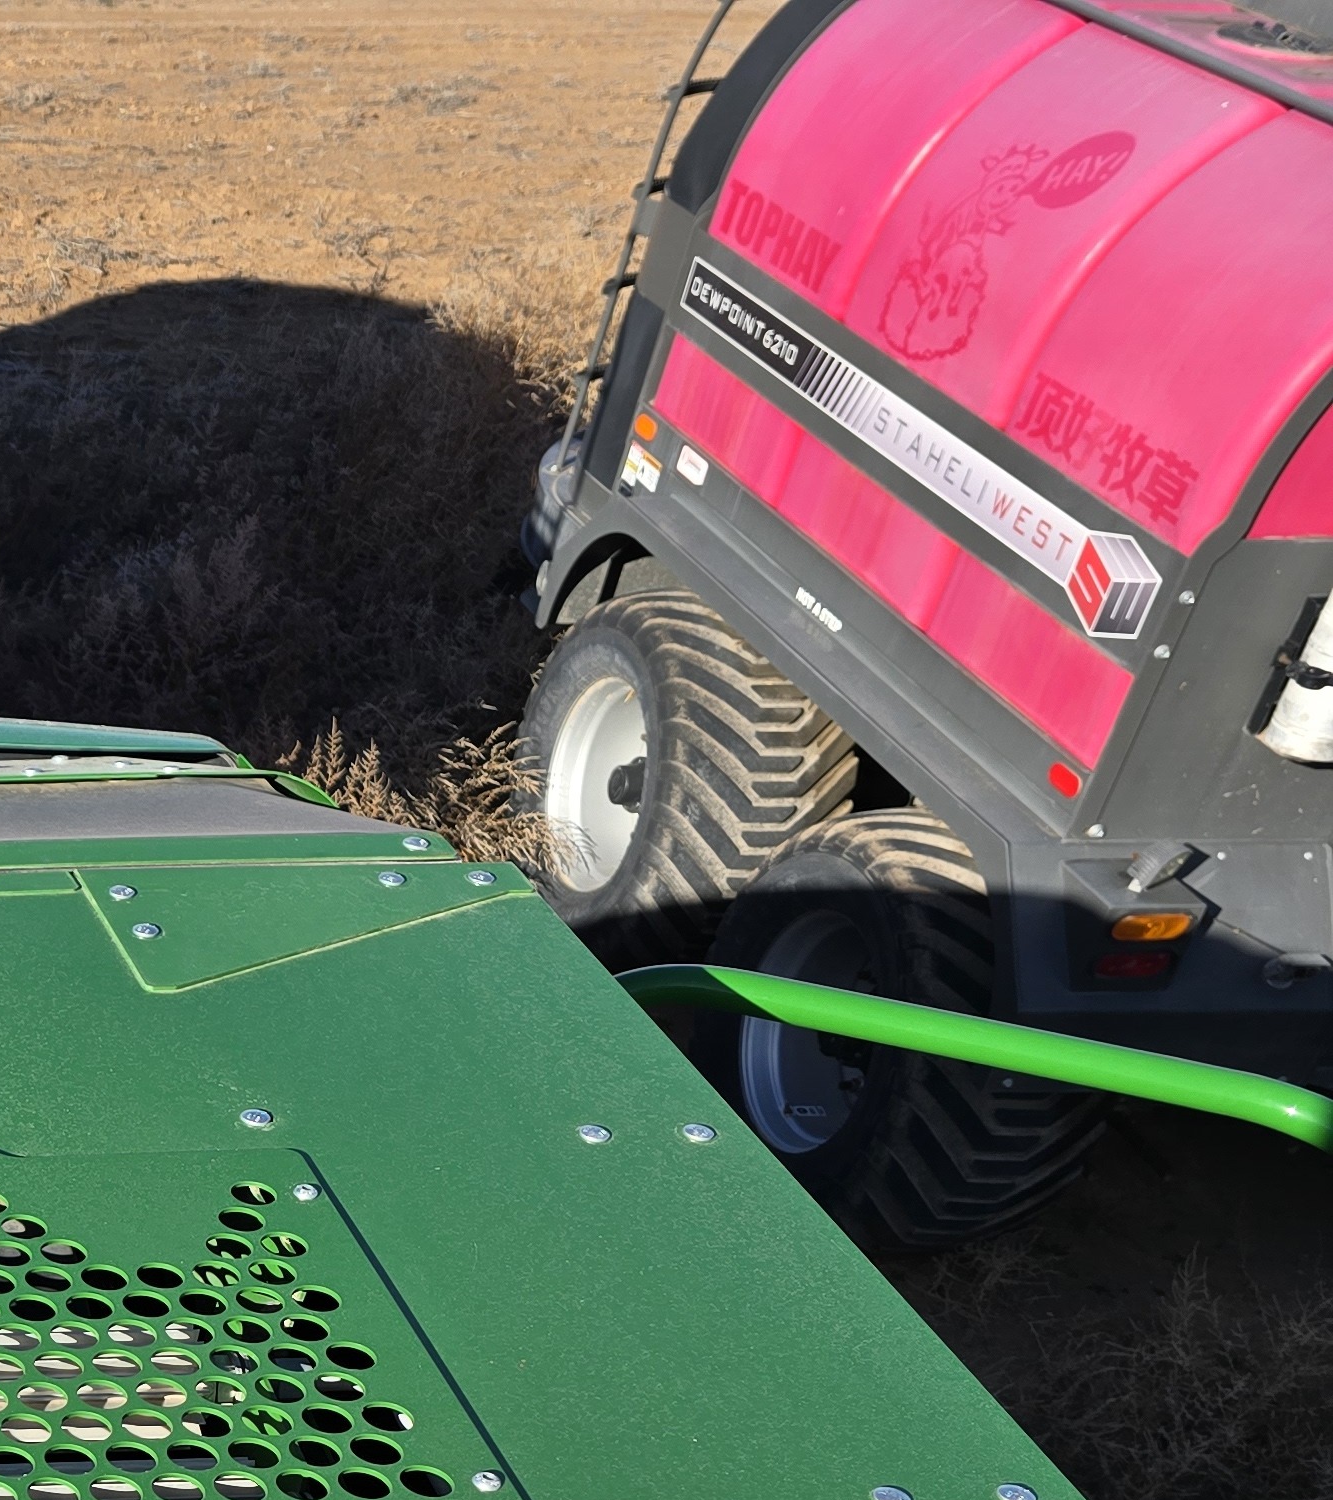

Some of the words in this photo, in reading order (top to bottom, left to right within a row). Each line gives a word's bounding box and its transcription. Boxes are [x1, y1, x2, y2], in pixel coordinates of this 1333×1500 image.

[1039, 151, 1129, 192] HAY!
[719, 179, 841, 294] TOPHAY
[690, 276, 767, 340] DEWPOINT
[762, 329, 799, 366] 6210
